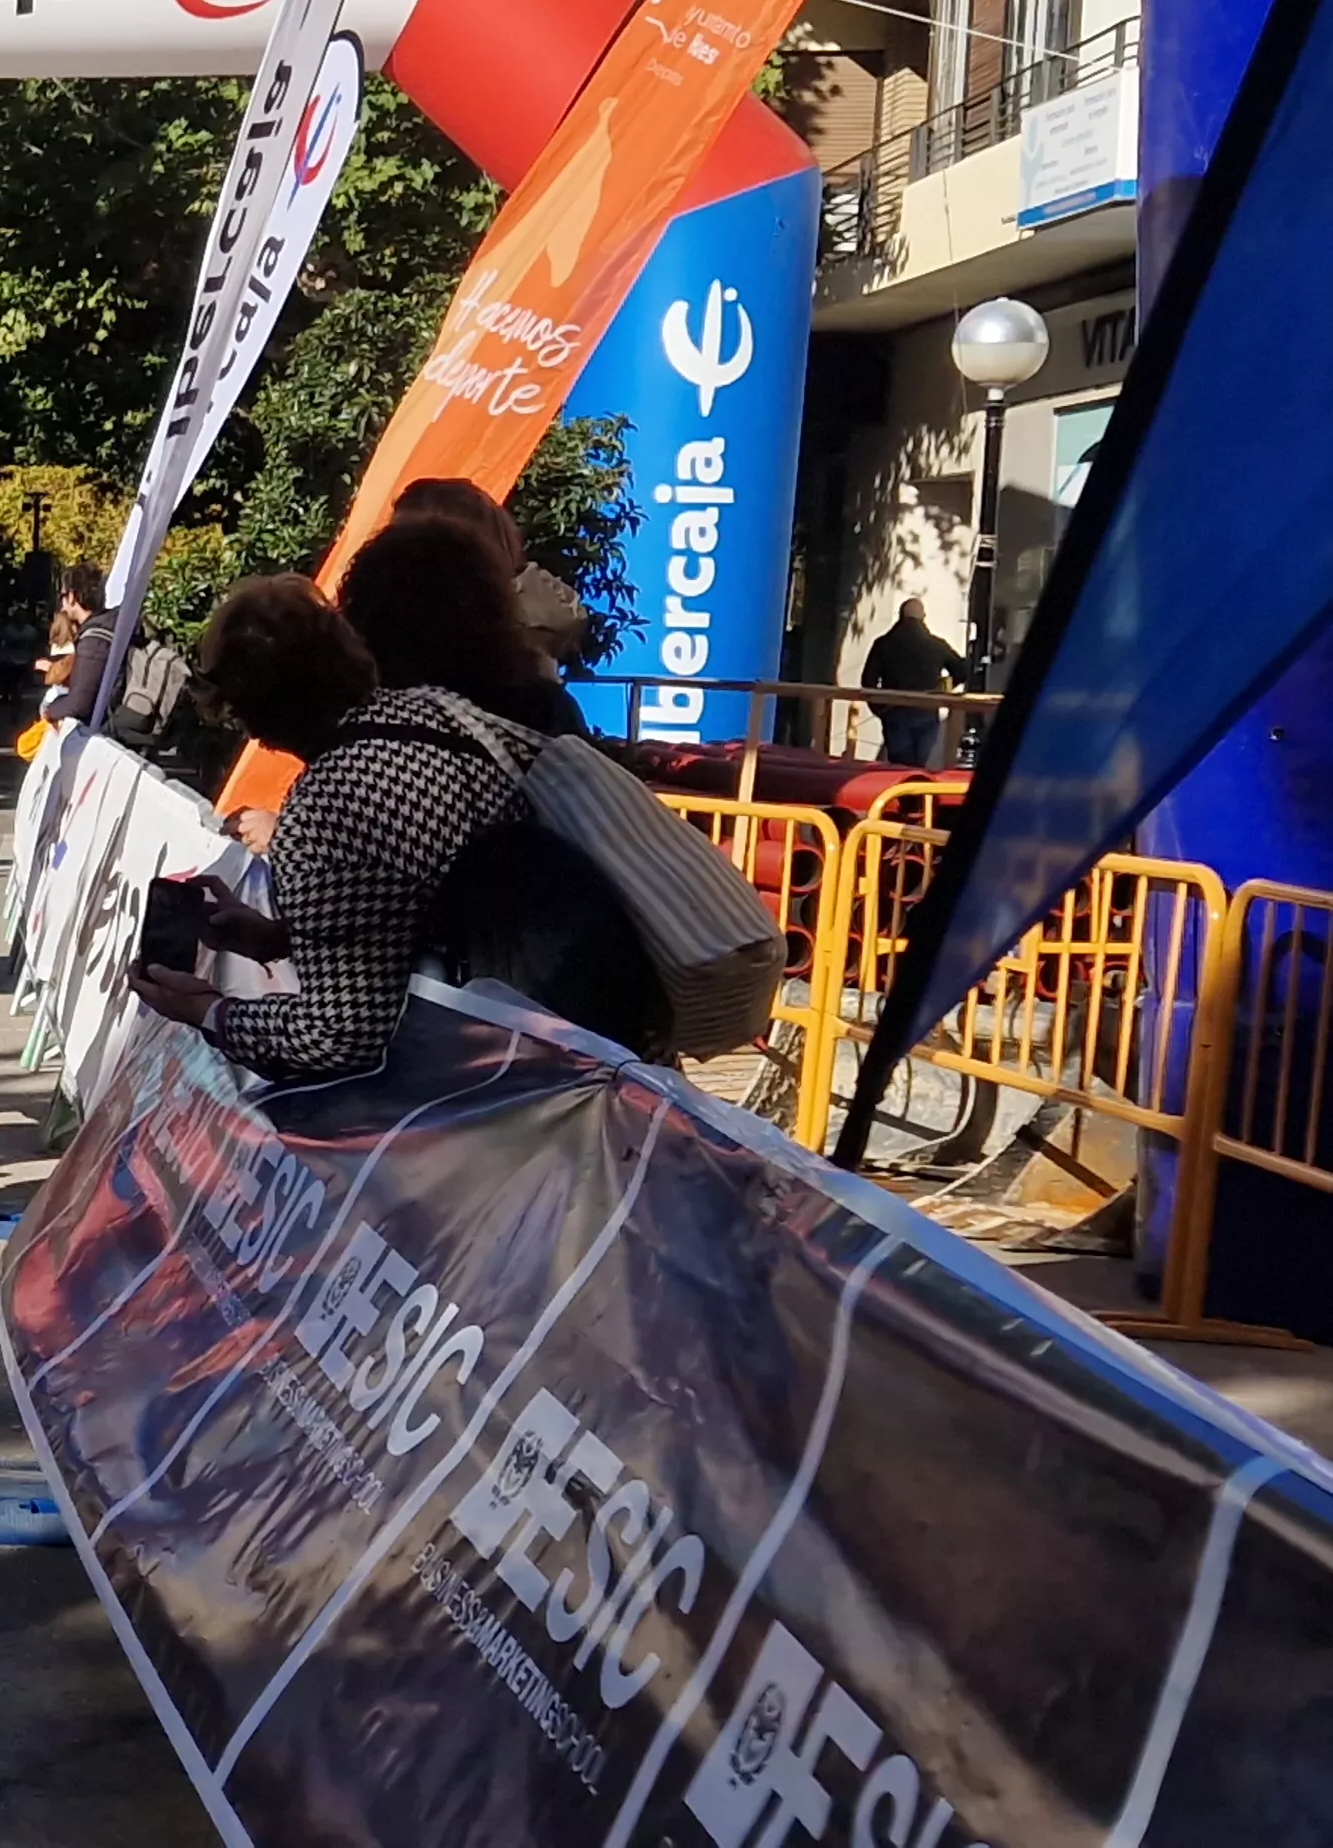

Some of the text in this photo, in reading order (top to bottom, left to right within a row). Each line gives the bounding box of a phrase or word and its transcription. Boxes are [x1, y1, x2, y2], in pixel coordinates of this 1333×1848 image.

[640, 436, 736, 746] Ibercaja
[219, 1137, 326, 1293] ESIC
[318, 1247, 484, 1456] ESIC
[496, 1429, 705, 1709] ESIC
